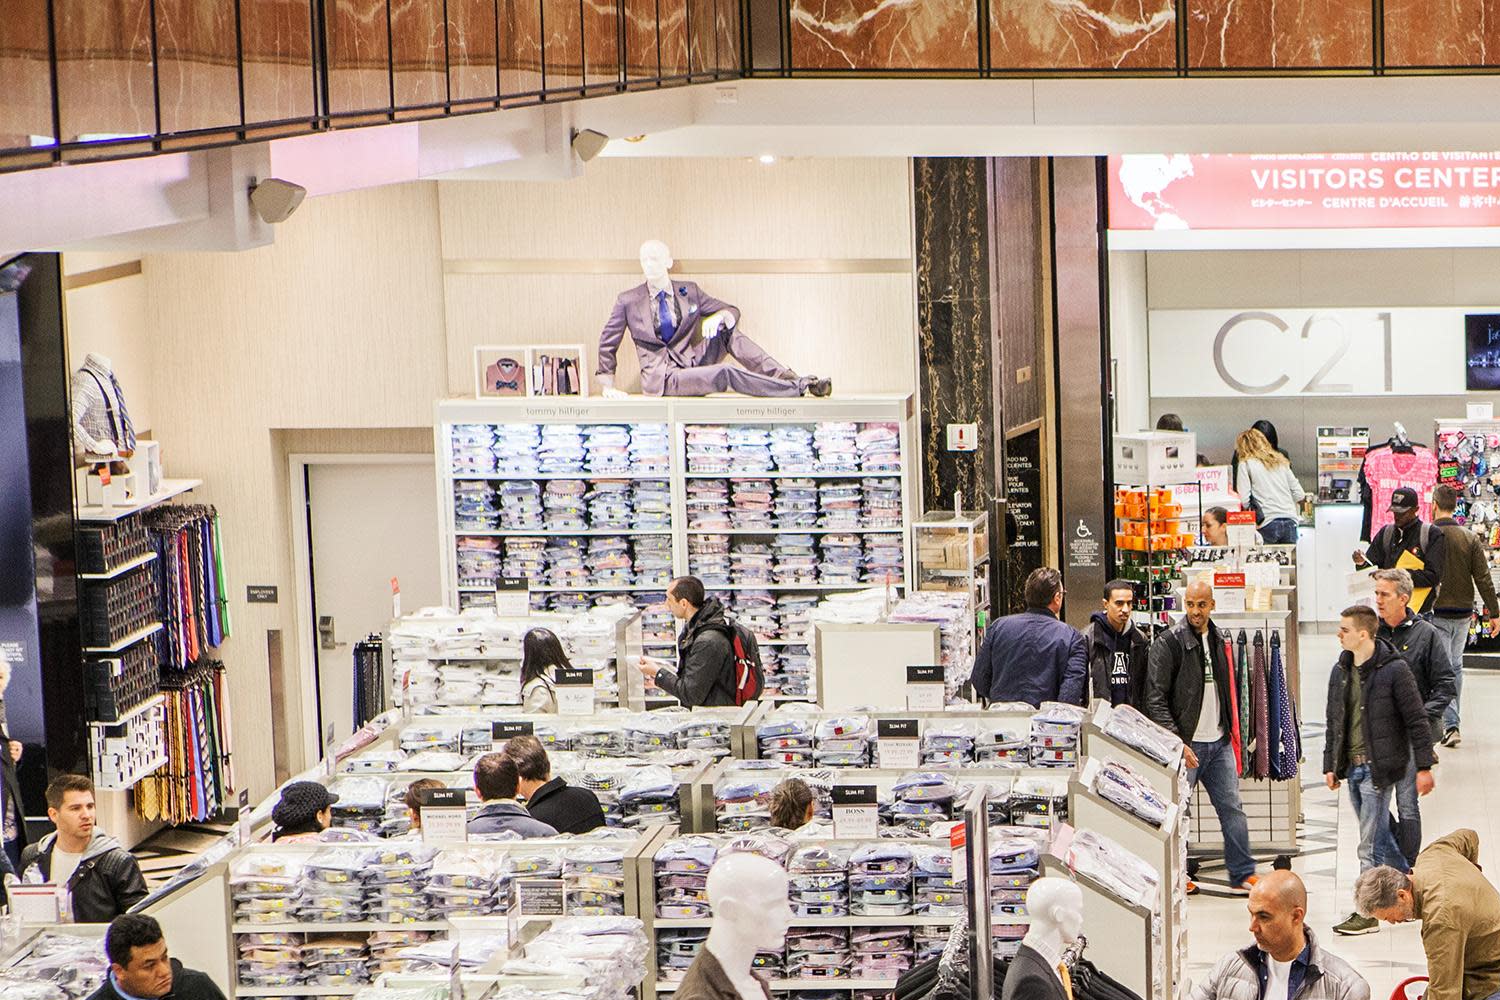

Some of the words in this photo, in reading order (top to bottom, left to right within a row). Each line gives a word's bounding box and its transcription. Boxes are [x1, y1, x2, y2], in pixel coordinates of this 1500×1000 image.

[1371, 152, 1419, 161] CENTRO
[1423, 152, 1438, 160] DE
[1251, 168, 1385, 189] VISITORS
[1322, 197, 1376, 208] CENTRE
[1380, 196, 1449, 208] D'ACCUEIL
[1213, 311, 1393, 395] C21
[526, 407, 557, 416] tommy
[558, 407, 590, 416] hilfiger
[736, 407, 765, 416] tommy
[767, 407, 796, 416] hilfiger
